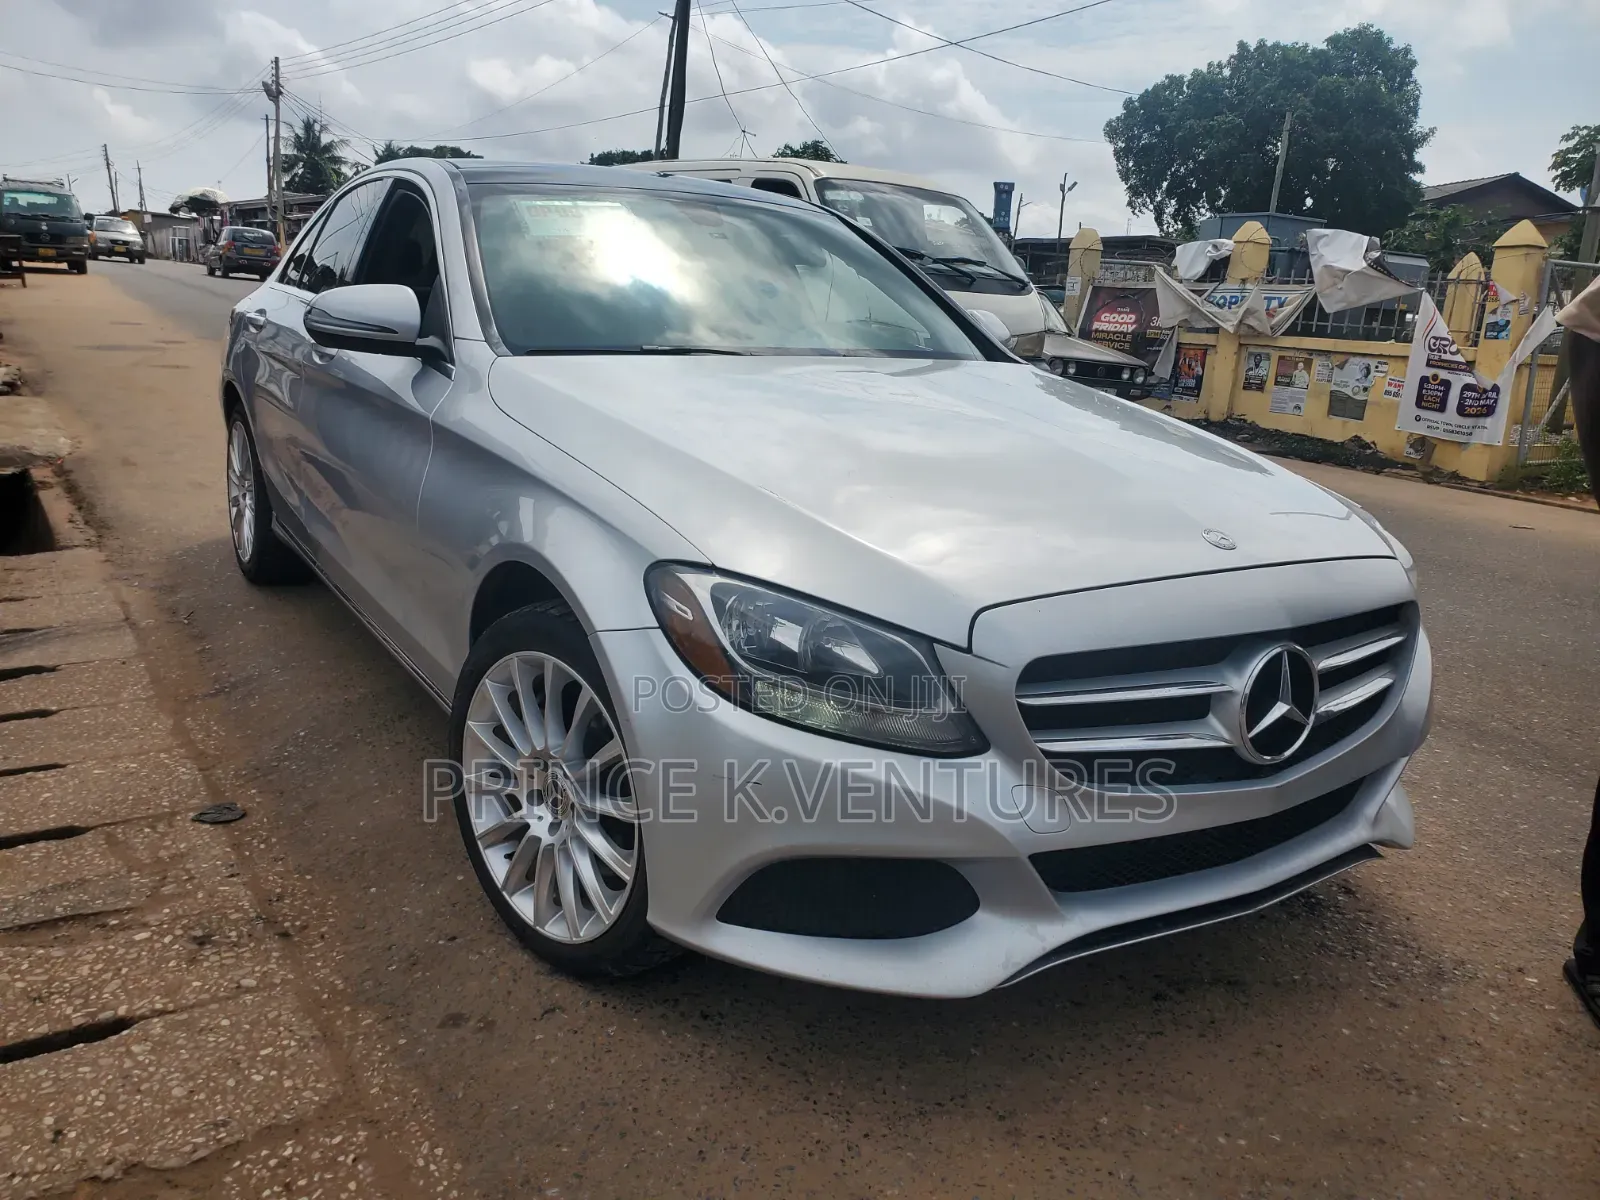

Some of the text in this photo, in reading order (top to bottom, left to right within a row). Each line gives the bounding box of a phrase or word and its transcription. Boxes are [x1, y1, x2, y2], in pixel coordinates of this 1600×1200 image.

[1101, 313, 1136, 323] GOOD
[1092, 322, 1137, 333] FRIDAY
[1091, 332, 1133, 342] MIRACLE
[1462, 391, 1480, 399] 29TH
[1421, 401, 1440, 409] NIGHT
[1464, 406, 1487, 414] 2026
